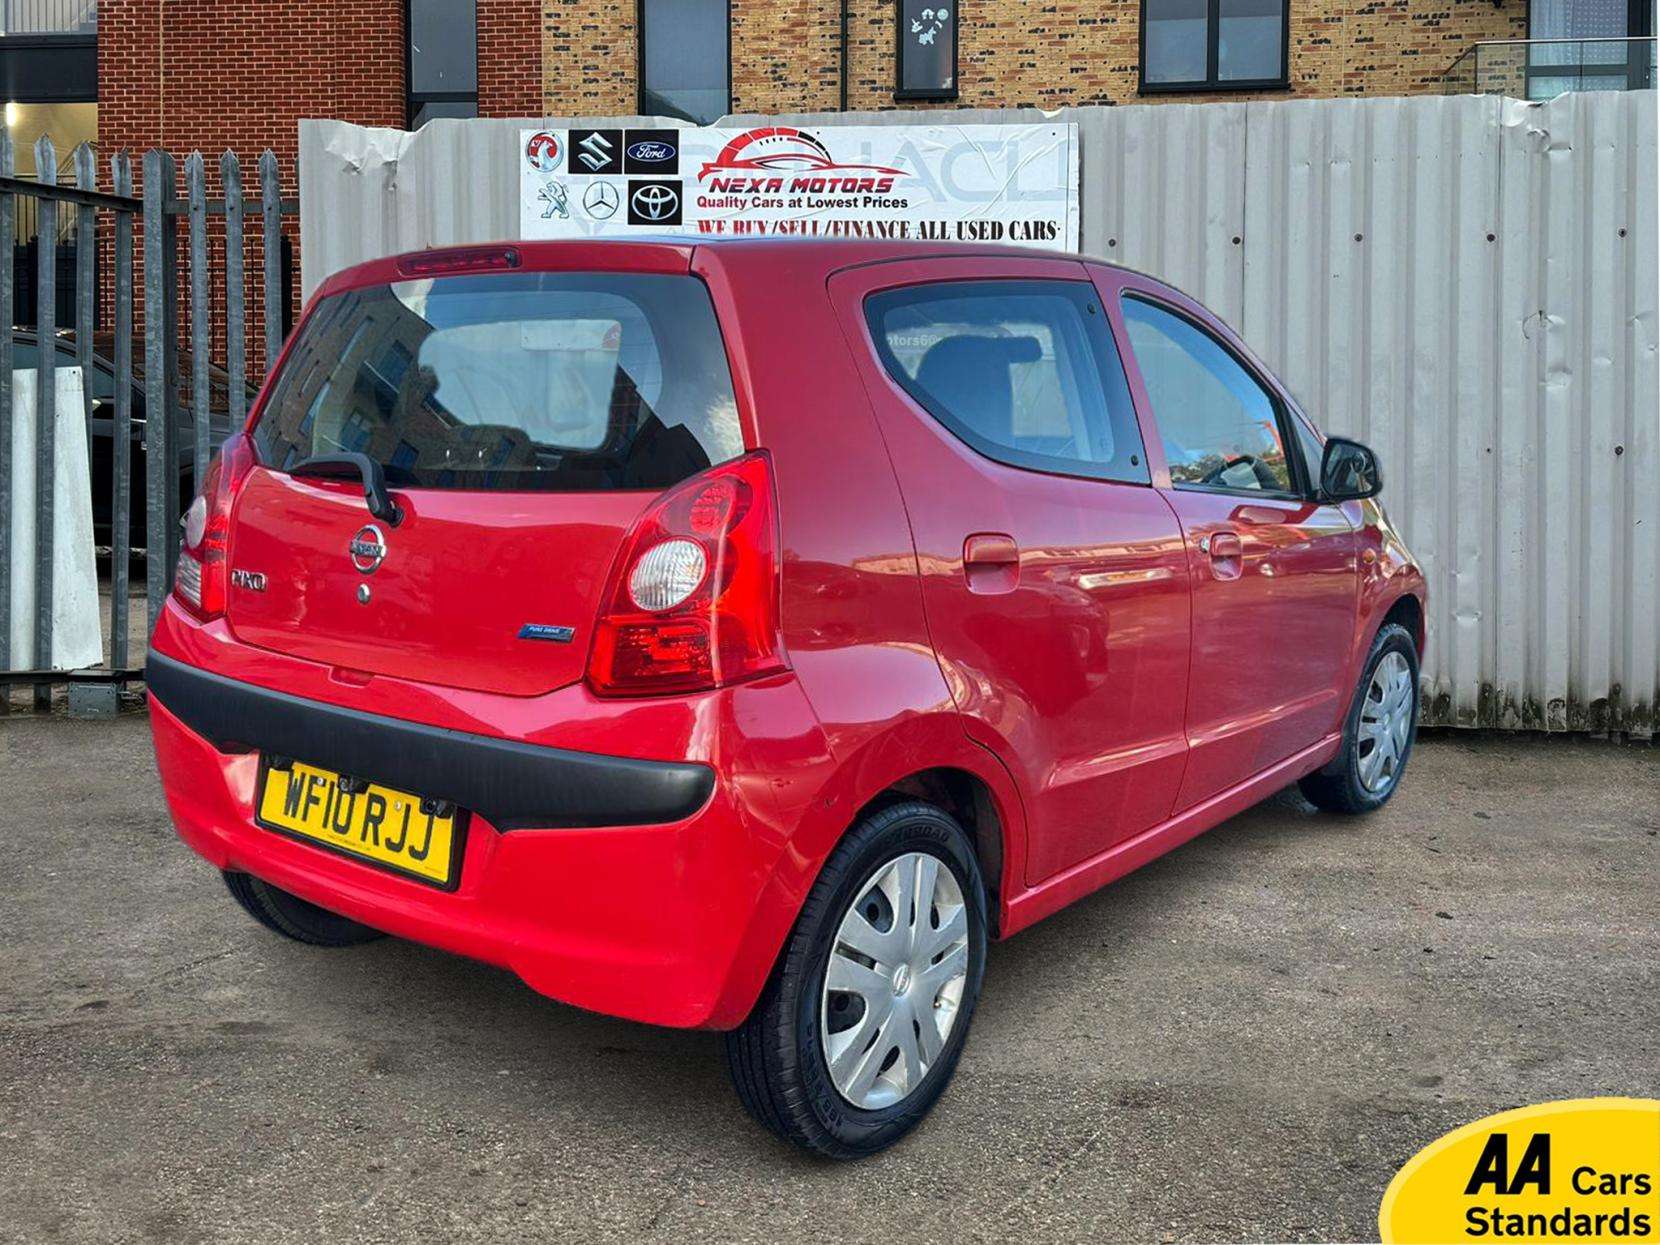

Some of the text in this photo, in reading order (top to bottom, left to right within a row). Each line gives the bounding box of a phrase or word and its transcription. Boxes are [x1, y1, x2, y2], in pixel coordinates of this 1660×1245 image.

[636, 144, 666, 159] Ford
[708, 177, 895, 193] NEXA MOTORS
[696, 196, 909, 210] Quality Cars at Lowest Prices
[697, 220, 727, 235] WE
[916, 220, 951, 240] ALL
[956, 221, 1004, 241] USED
[1008, 220, 1057, 241] CARS
[283, 769, 435, 862] WF10 RJJ
